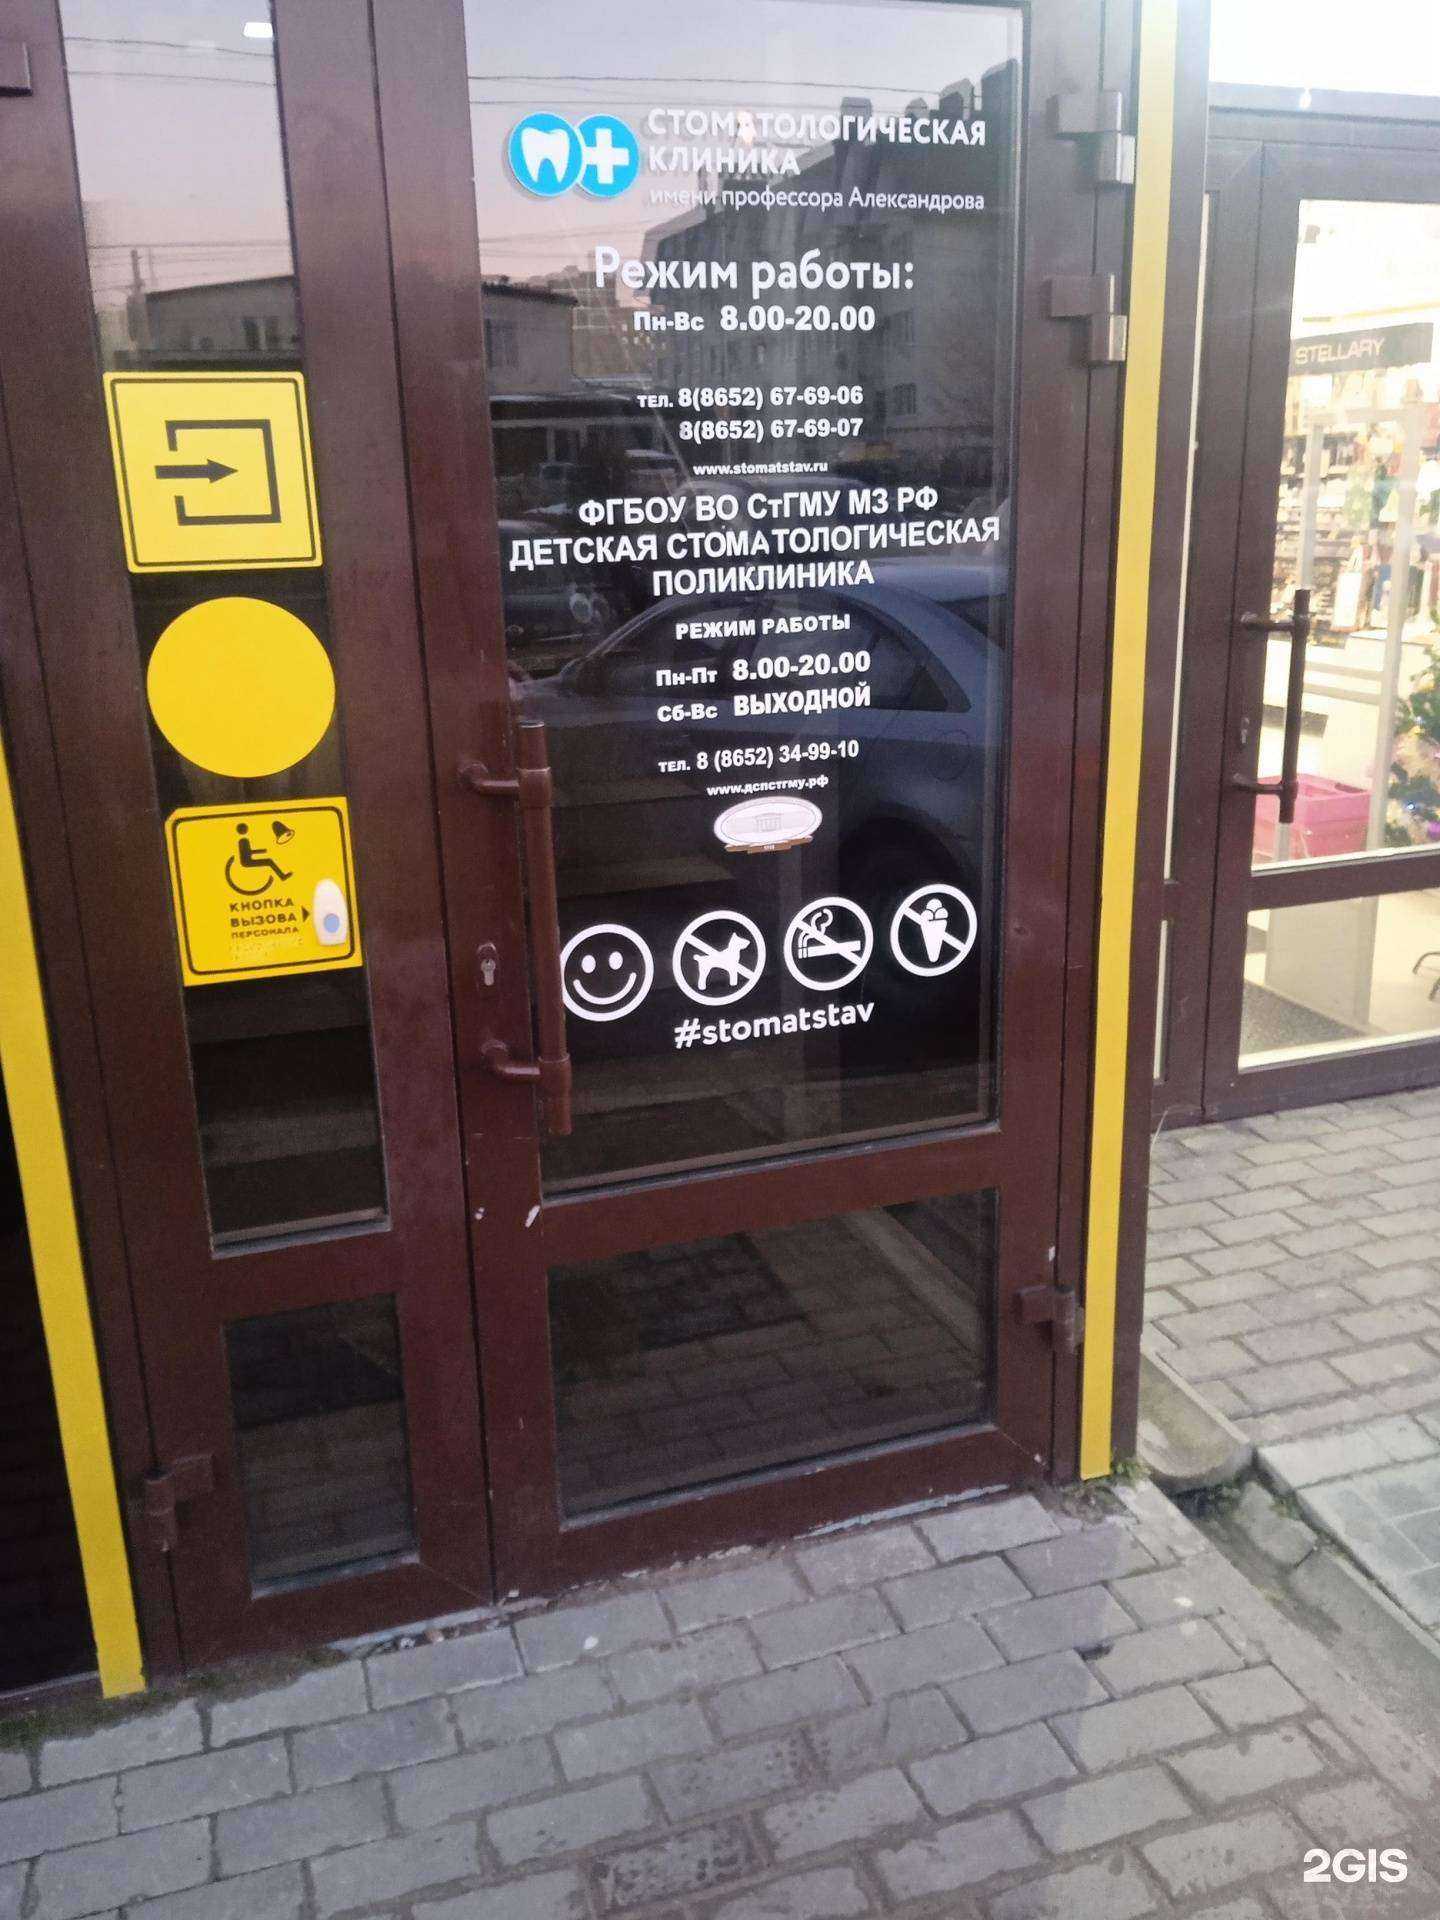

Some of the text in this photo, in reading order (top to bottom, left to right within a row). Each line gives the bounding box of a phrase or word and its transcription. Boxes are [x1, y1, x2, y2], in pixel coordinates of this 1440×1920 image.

[648, 108, 986, 146] СТОМАТОЛОГИЧЕСКАЯ
[648, 146, 801, 175] КЛИНИКА
[650, 185, 985, 214] имени профессора Александрова
[595, 246, 914, 299] Режим работы:
[634, 305, 876, 332] Пн-Вс 8.00-20.00
[1295, 337, 1385, 365] STELLARY
[637, 385, 863, 411] тел. 8(8652) 67-69-06
[679, 418, 863, 443] 8(8652) 67-69-07
[693, 460, 828, 476] www.stomatstav.ru
[578, 484, 938, 527] ФГБОУ ВО СтГМУ МЗ РФ
[509, 517, 1000, 571] ДЕТСКАЯ СТОМАТОЛОГИЧЕСКАЯ
[653, 560, 875, 597] ПОЛИКЛИНИКА
[676, 612, 851, 640] РЕЖИМ РАБОТЫ
[656, 650, 871, 687] Пн-Пт 8.00-20.00
[657, 681, 871, 723] Сб-Вс ВЫХОДНОЙ
[658, 740, 859, 773] тел. 8 (8652) 34-99-10
[706, 774, 829, 796] www.дспстгму.рф
[229, 898, 294, 912] КНОПКА
[230, 913, 297, 927] ВЫЗОВА
[231, 926, 299, 939] ПЕРСОНАЛА
[674, 1002, 875, 1050] #stomatstav
